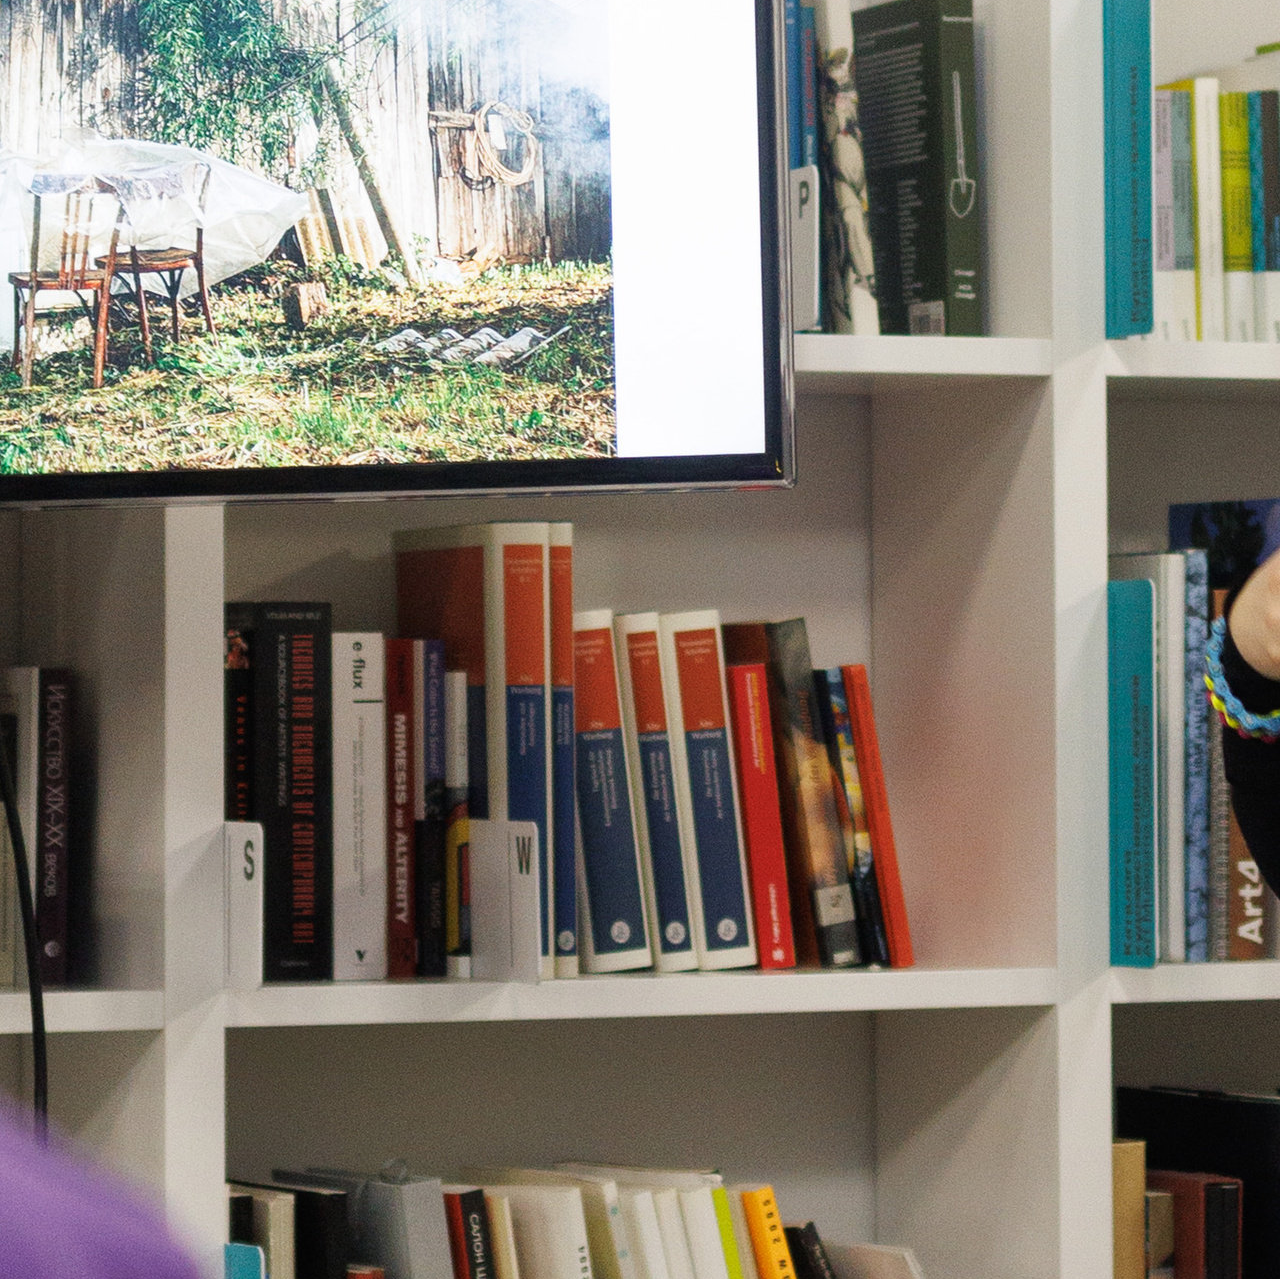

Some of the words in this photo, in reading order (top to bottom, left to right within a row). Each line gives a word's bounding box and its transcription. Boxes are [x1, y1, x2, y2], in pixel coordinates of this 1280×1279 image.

[797, 181, 811, 219] P
[291, 633, 314, 690] THEORIES
[291, 695, 314, 720] AND
[291, 725, 314, 795] DOCUMENTS
[394, 713, 409, 804] MIMESIS
[291, 801, 314, 816] OF
[395, 808, 404, 828] AND
[242, 839, 256, 882] S
[291, 822, 314, 916] CONTEMPORARY
[515, 835, 533, 875] W
[394, 831, 409, 924] ALTERITY
[291, 923, 314, 945] ART
[469, 1213, 486, 1264] САЛОН
